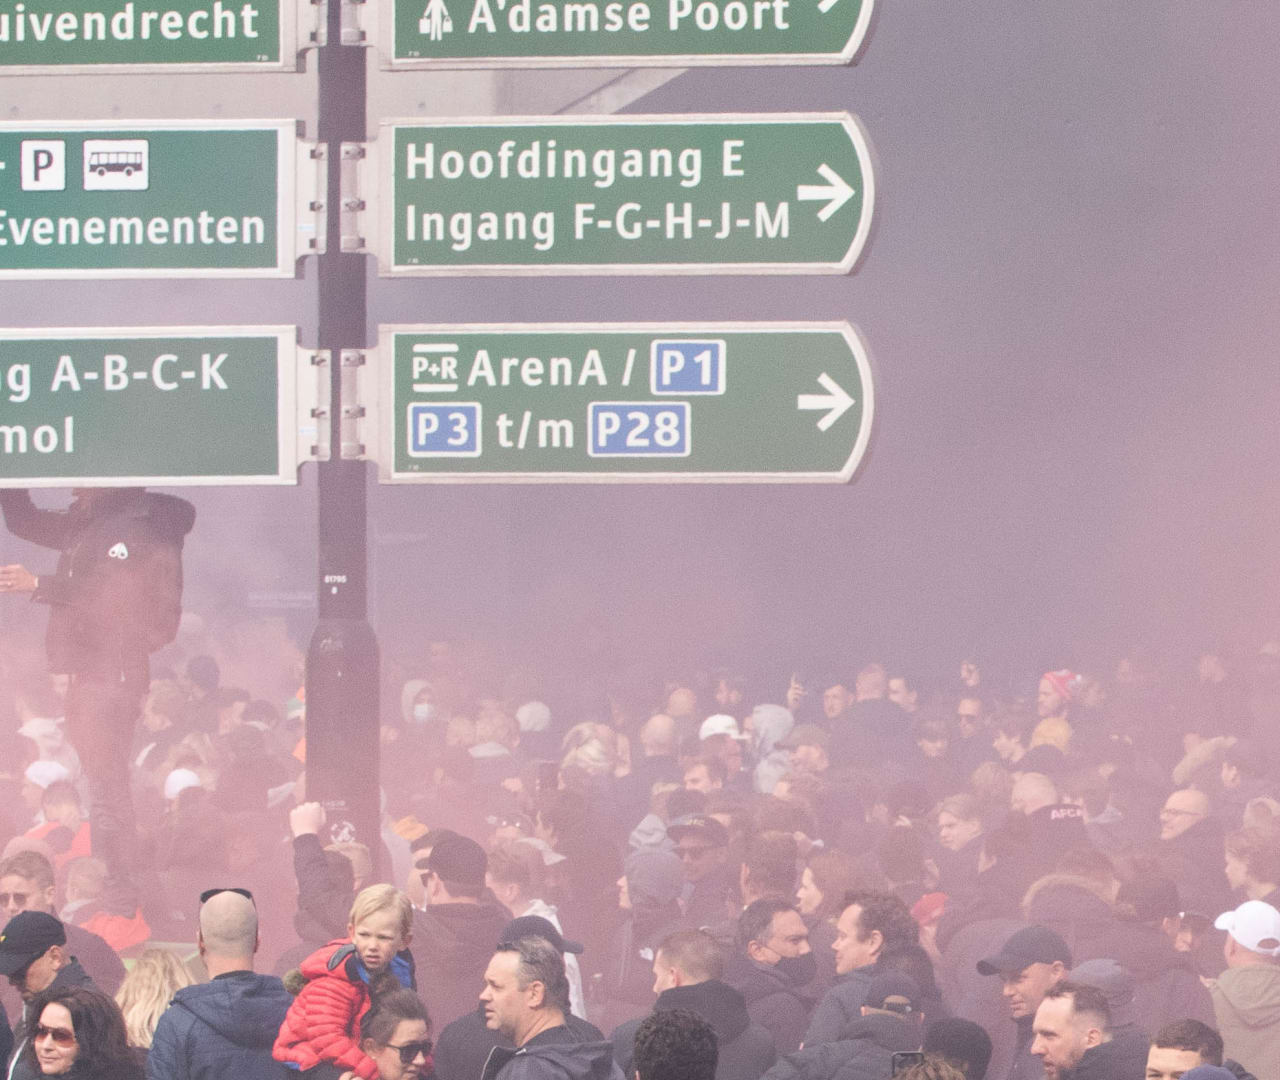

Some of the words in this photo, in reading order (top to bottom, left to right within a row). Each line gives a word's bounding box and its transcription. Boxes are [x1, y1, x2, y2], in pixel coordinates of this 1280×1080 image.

[468, 0, 651, 34] A'damse
[669, 0, 790, 31] Poort
[406, 140, 702, 188] Hoofdingang
[722, 140, 745, 177] E
[406, 204, 555, 251] Ingang
[574, 202, 790, 239] F-G-H-J-M
[51, 353, 229, 392] A-B-C-K
[412, 356, 458, 380] P+R
[467, 349, 607, 386] ArenA
[496, 410, 574, 450] t/m
[597, 411, 680, 447] P28
